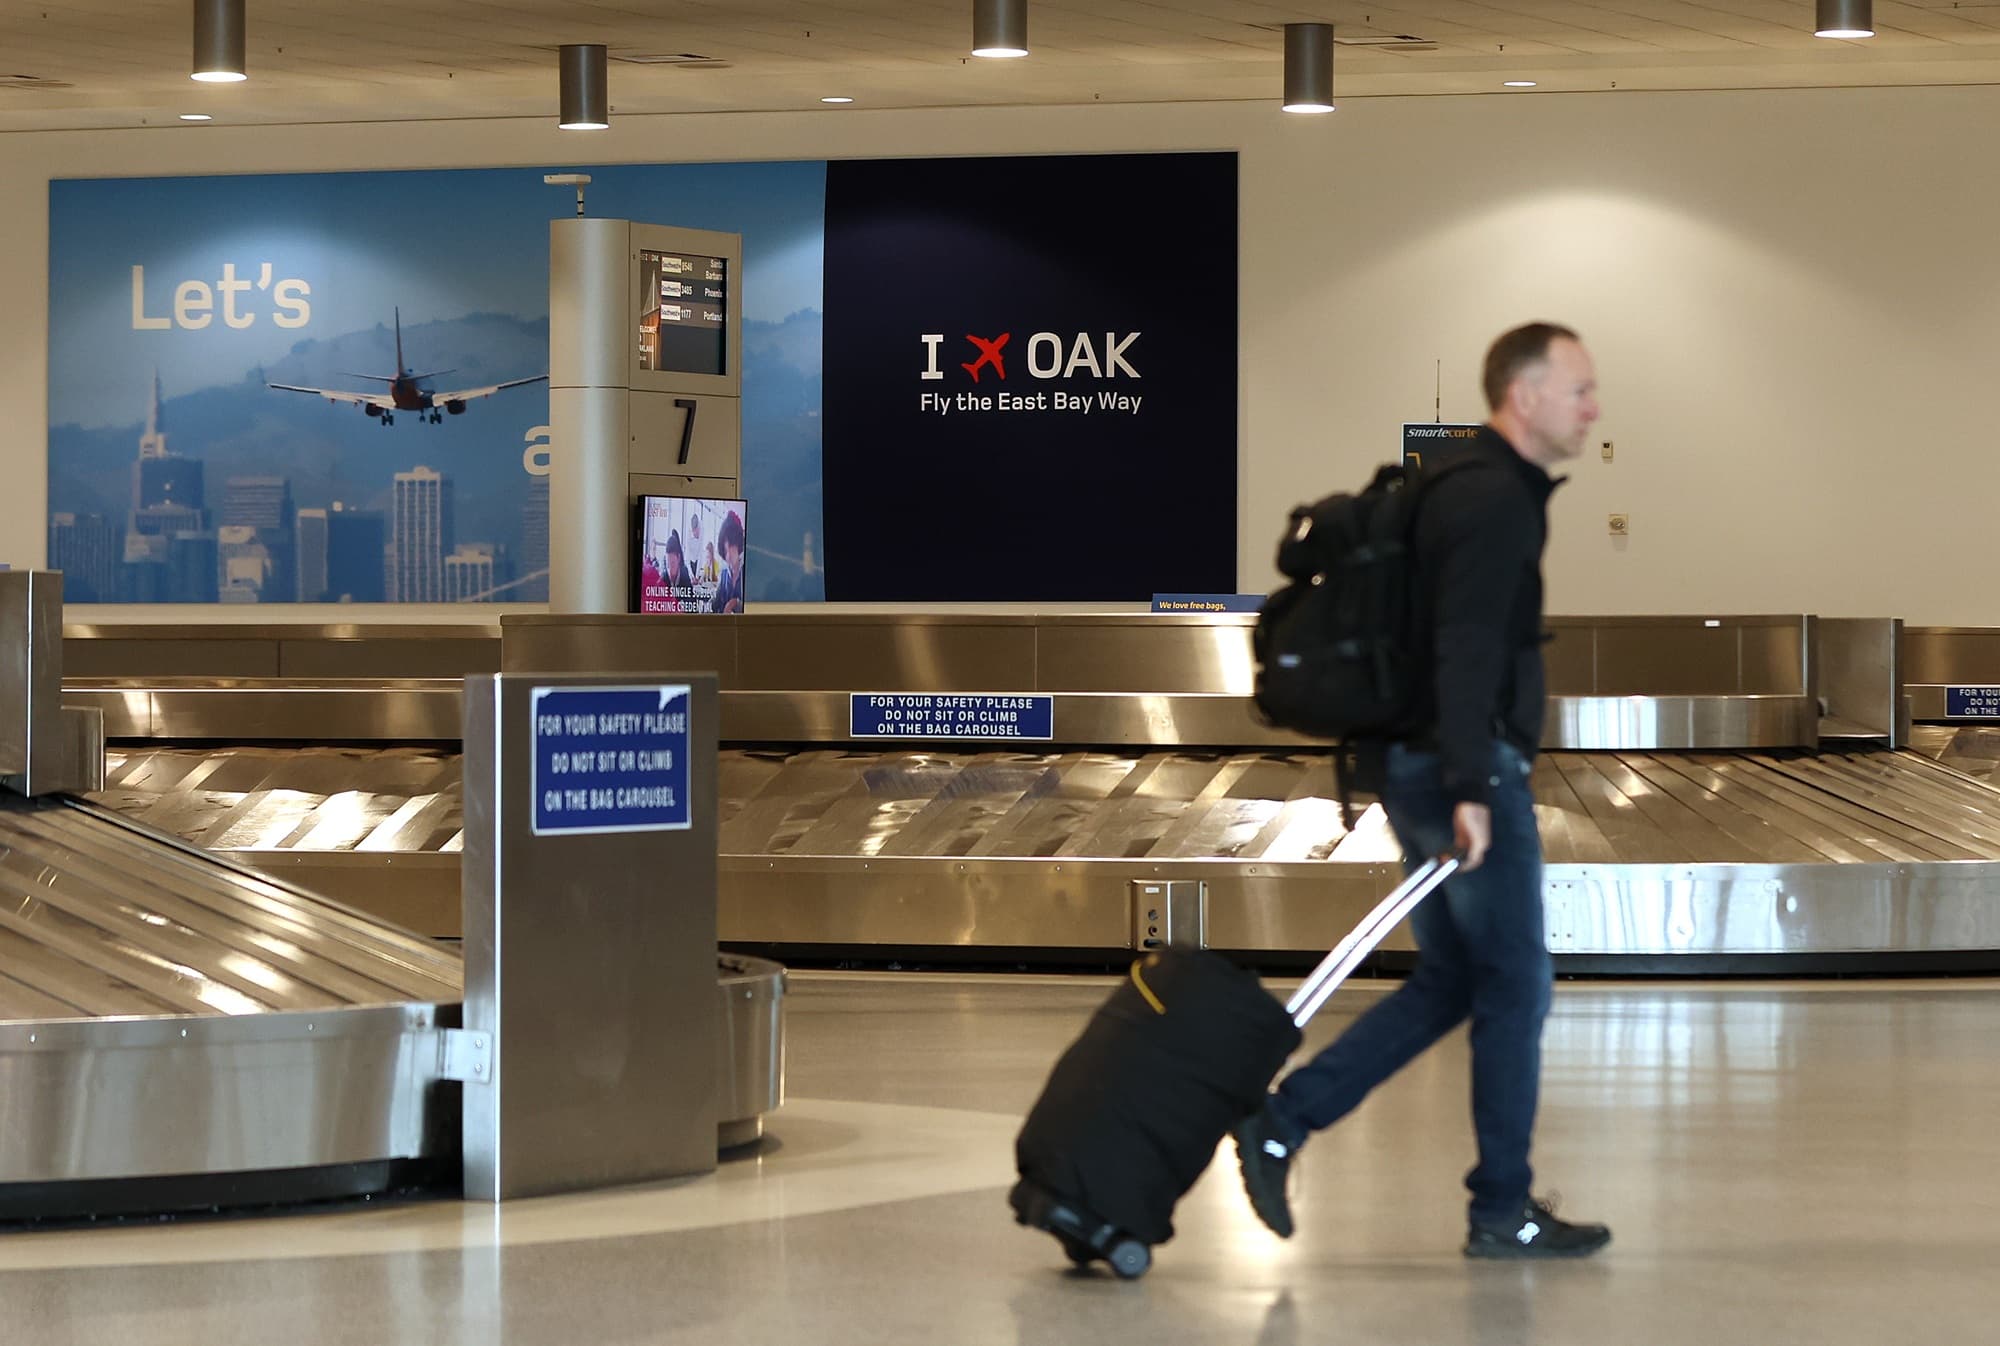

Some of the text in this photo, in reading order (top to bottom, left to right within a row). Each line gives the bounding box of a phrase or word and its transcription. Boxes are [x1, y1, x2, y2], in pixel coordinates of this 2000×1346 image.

[131, 262, 311, 330] Let's
[921, 332, 1142, 380] I OAK
[921, 392, 1142, 415] Fly the East Bay Way
[675, 399, 697, 464] 7
[646, 586, 668, 597] ONLINE
[670, 586, 692, 598] SINGLE
[646, 601, 676, 612] TEACHING
[1159, 601, 1171, 609] We
[1190, 601, 1204, 609] free
[871, 697, 1032, 708] FOR YOUR SAFETY PLEASE
[1970, 698, 1983, 706] DO
[539, 713, 685, 736] FOR YOUR SAFETY PLEASE
[886, 711, 1018, 722] DO NOT SIT OR CLIMB
[878, 724, 1020, 735] ON THE BAG CAROUSEL
[552, 750, 672, 773] DO NOT SIT OR CLIMB
[545, 786, 675, 812] ON THE BAG CAROUSEL
